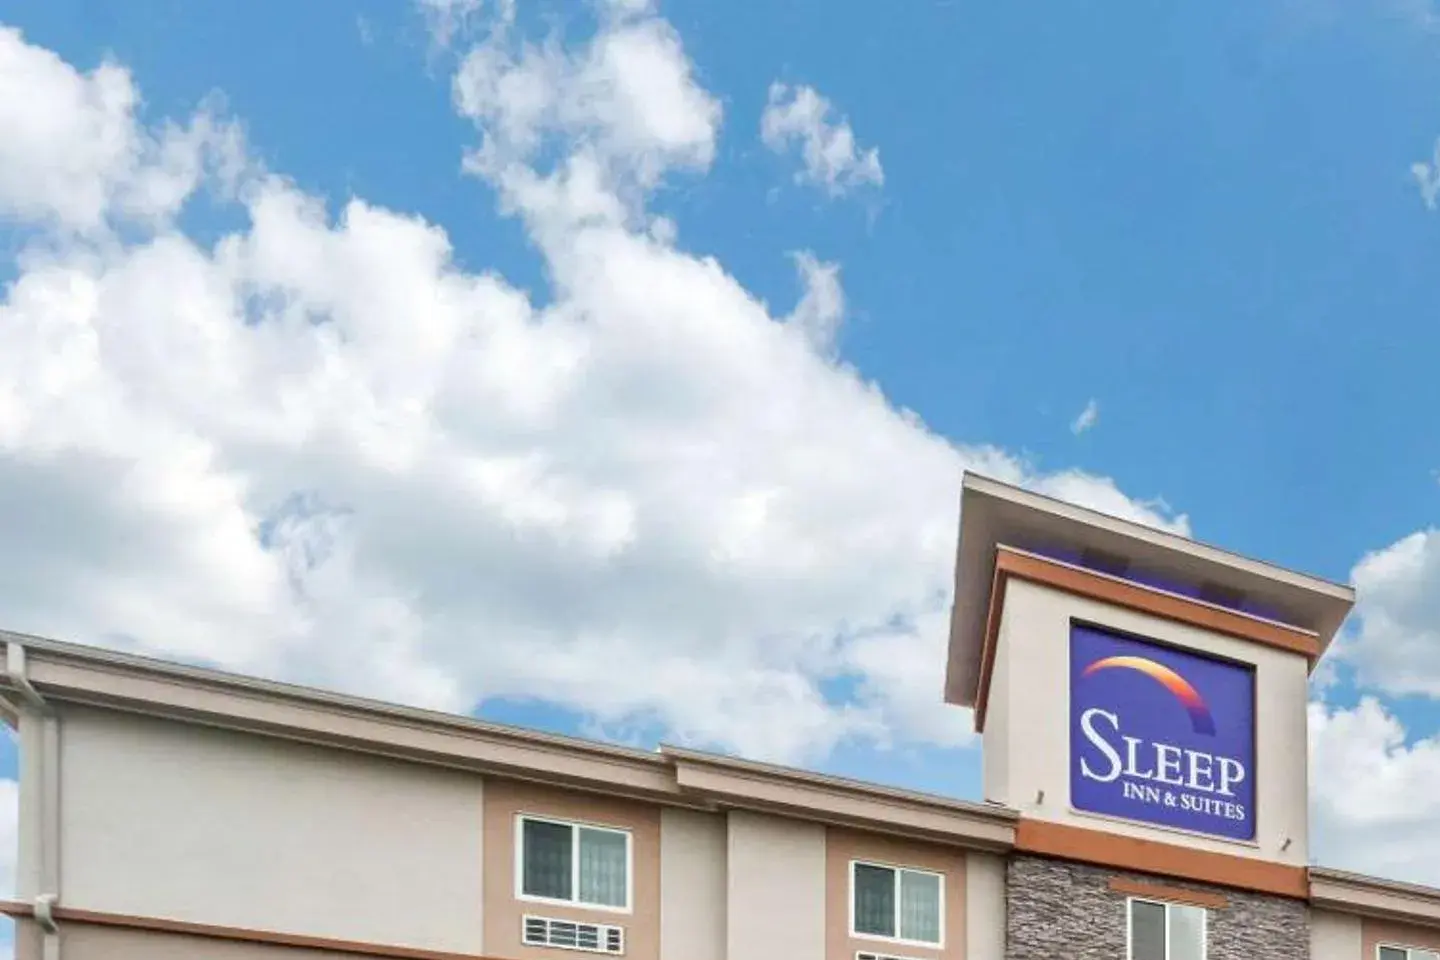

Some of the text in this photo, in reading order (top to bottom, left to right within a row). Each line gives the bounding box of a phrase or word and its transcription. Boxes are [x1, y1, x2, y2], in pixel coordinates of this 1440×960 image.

[1080, 708, 1245, 796] SLEEP
[1122, 781, 1246, 821] INN & SUITES
